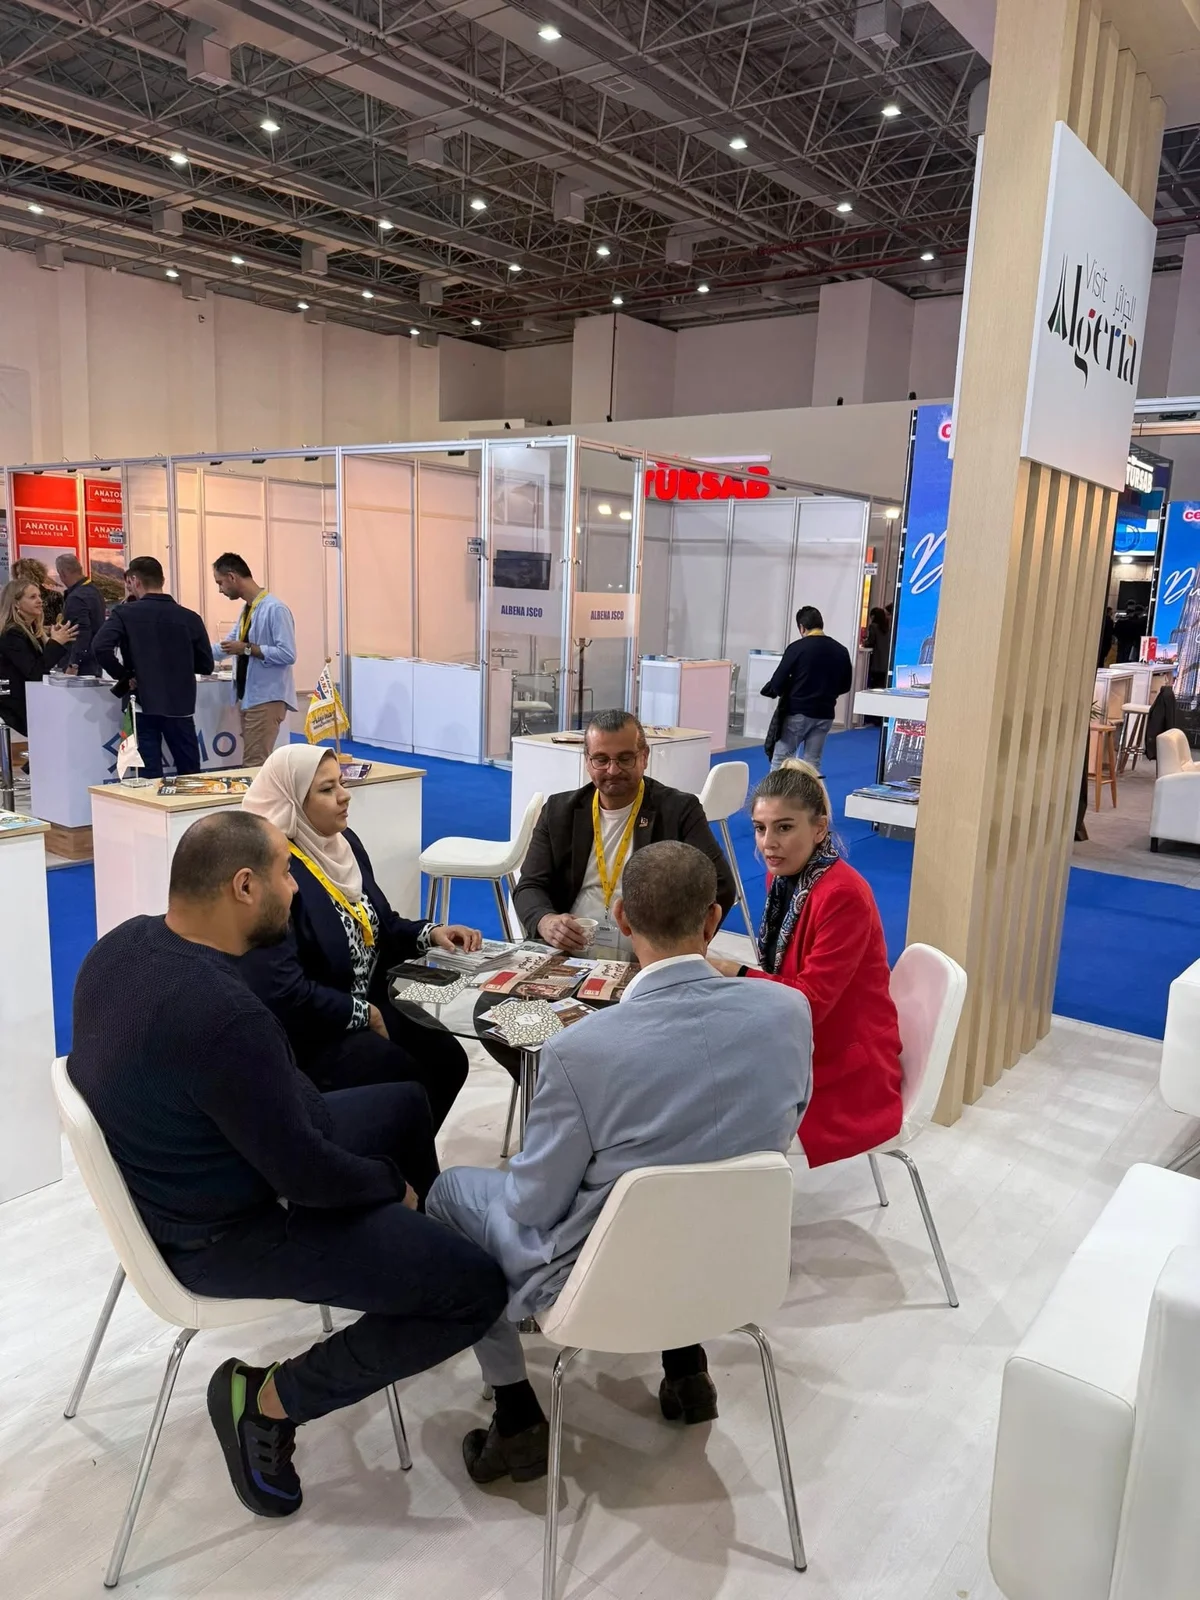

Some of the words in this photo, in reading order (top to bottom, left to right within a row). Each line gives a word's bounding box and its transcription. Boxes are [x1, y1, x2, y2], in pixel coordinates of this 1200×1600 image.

[1086, 253, 1108, 303] Visit
[1047, 253, 1137, 389] Algeria
[25, 521, 69, 532] ANATOLIA
[30, 529, 52, 537] BALKAN
[501, 604, 525, 617] ALBENA
[526, 606, 543, 618] JSCO
[590, 610, 610, 620] ALBENA
[611, 610, 624, 620] JSCO
